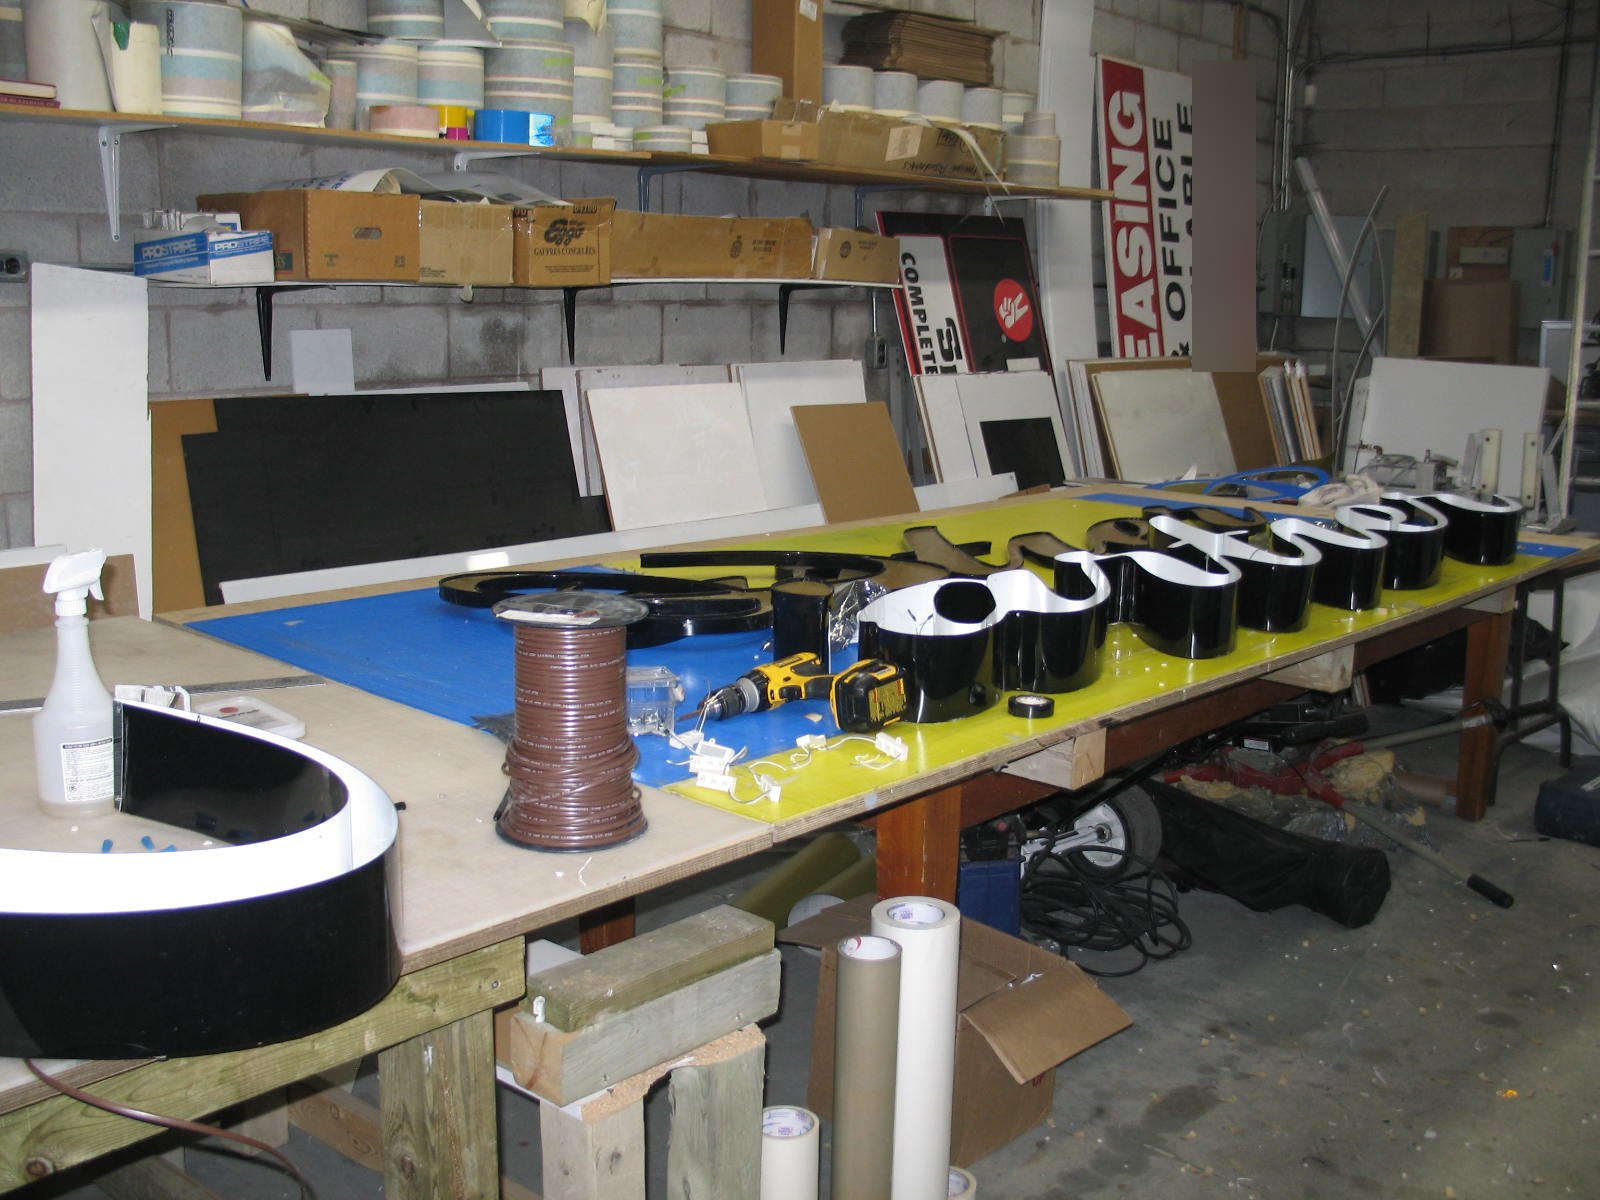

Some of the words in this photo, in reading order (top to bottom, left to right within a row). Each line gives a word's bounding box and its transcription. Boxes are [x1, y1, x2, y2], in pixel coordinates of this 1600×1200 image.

[544, 219, 585, 245] Eggo
[1151, 116, 1187, 322] OFFICE
[901, 252, 939, 375] COMPLETE
